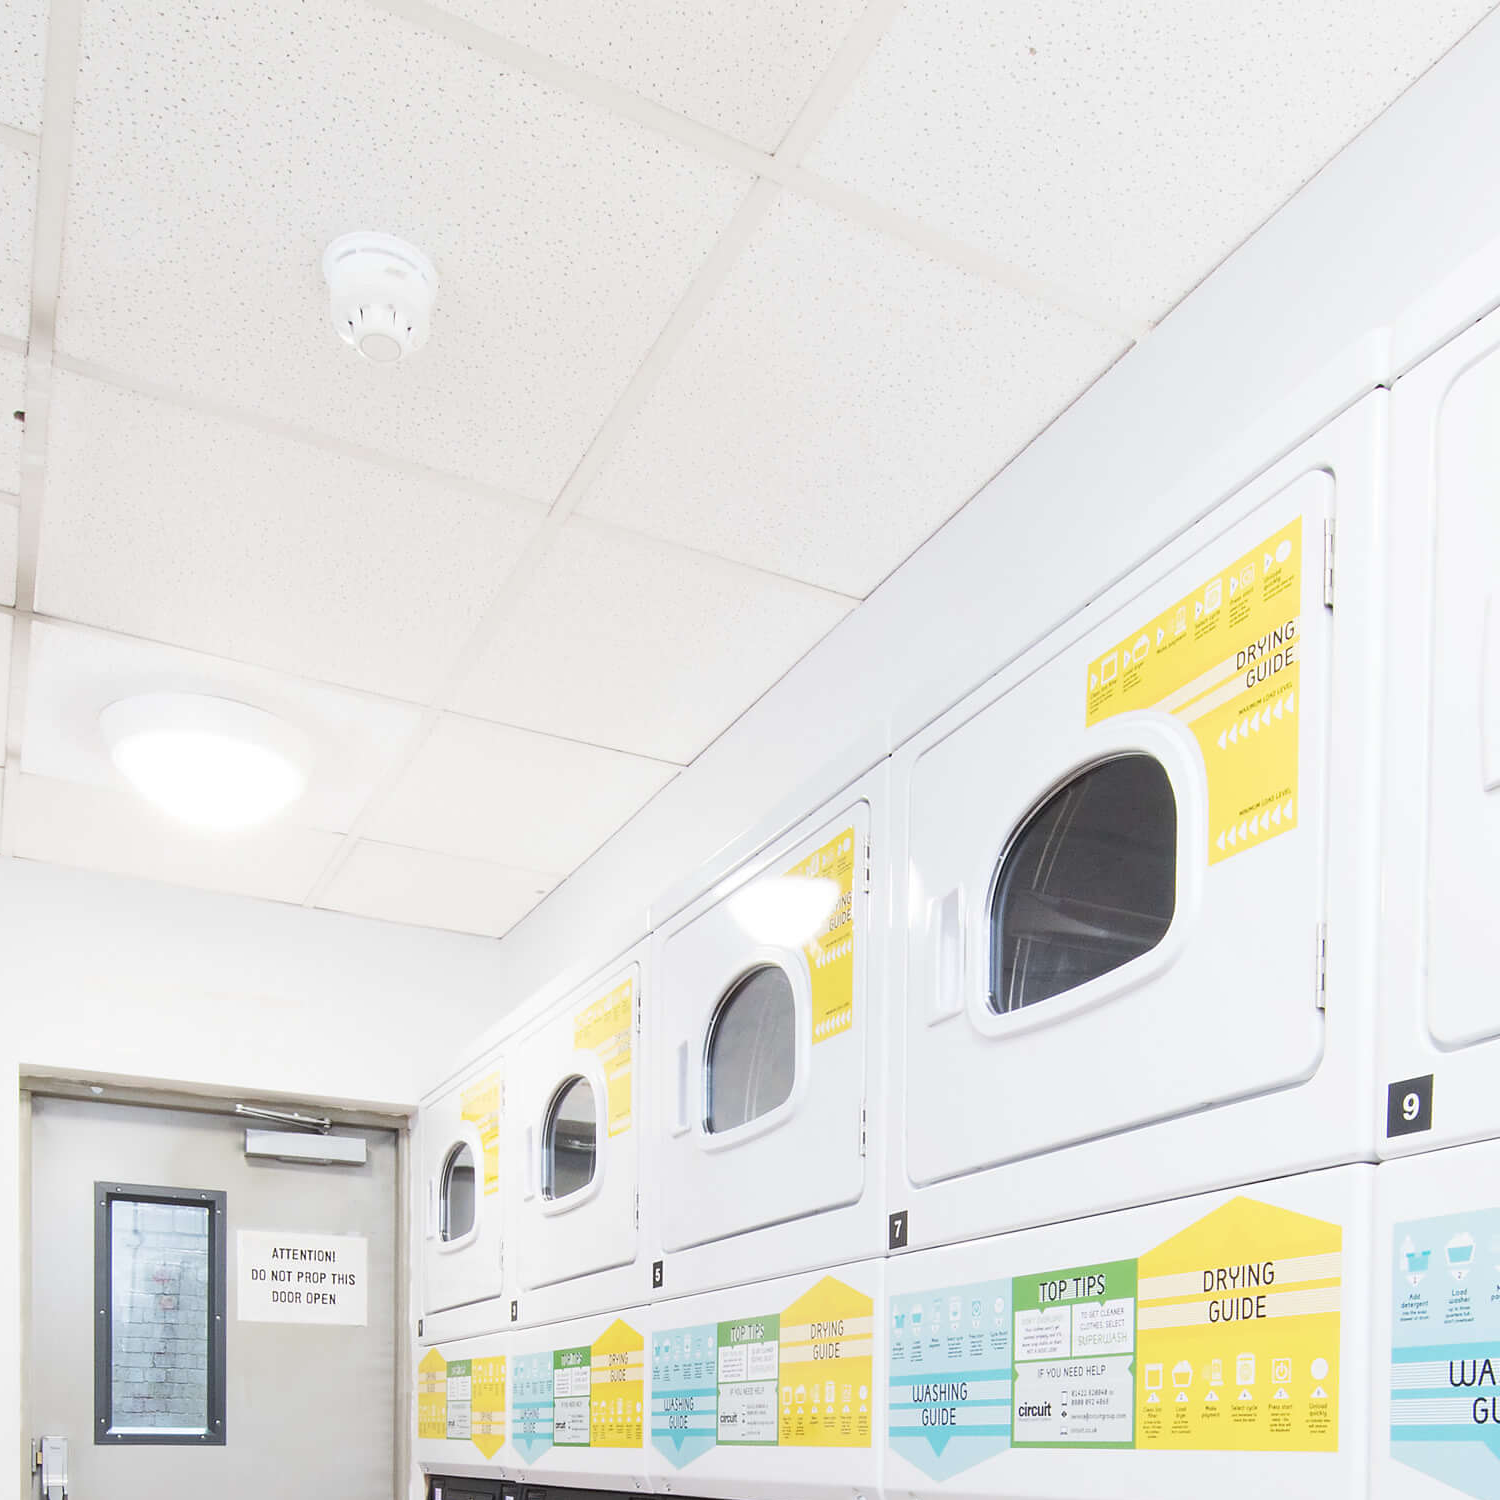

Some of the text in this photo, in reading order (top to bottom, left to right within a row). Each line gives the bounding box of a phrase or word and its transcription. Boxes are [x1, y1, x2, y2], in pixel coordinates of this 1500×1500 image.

[1236, 620, 1295, 671] DRYING
[1246, 646, 1294, 688] GUIDE
[1403, 1093, 1420, 1120] 9
[894, 1220, 901, 1239] 7
[272, 1248, 335, 1262] ATTENTION!
[252, 1269, 355, 1285] DO NOT PROP THIS
[655, 1268, 660, 1281] 5
[1203, 1262, 1275, 1292] DRYING
[272, 1291, 336, 1304] DOOR OPEN
[1040, 1274, 1105, 1301] TOP TIPS
[1209, 1295, 1267, 1323] GUIDE
[912, 1382, 967, 1403] WASHING
[921, 1408, 957, 1426] GUIDE
[1018, 1400, 1052, 1418] circuit
